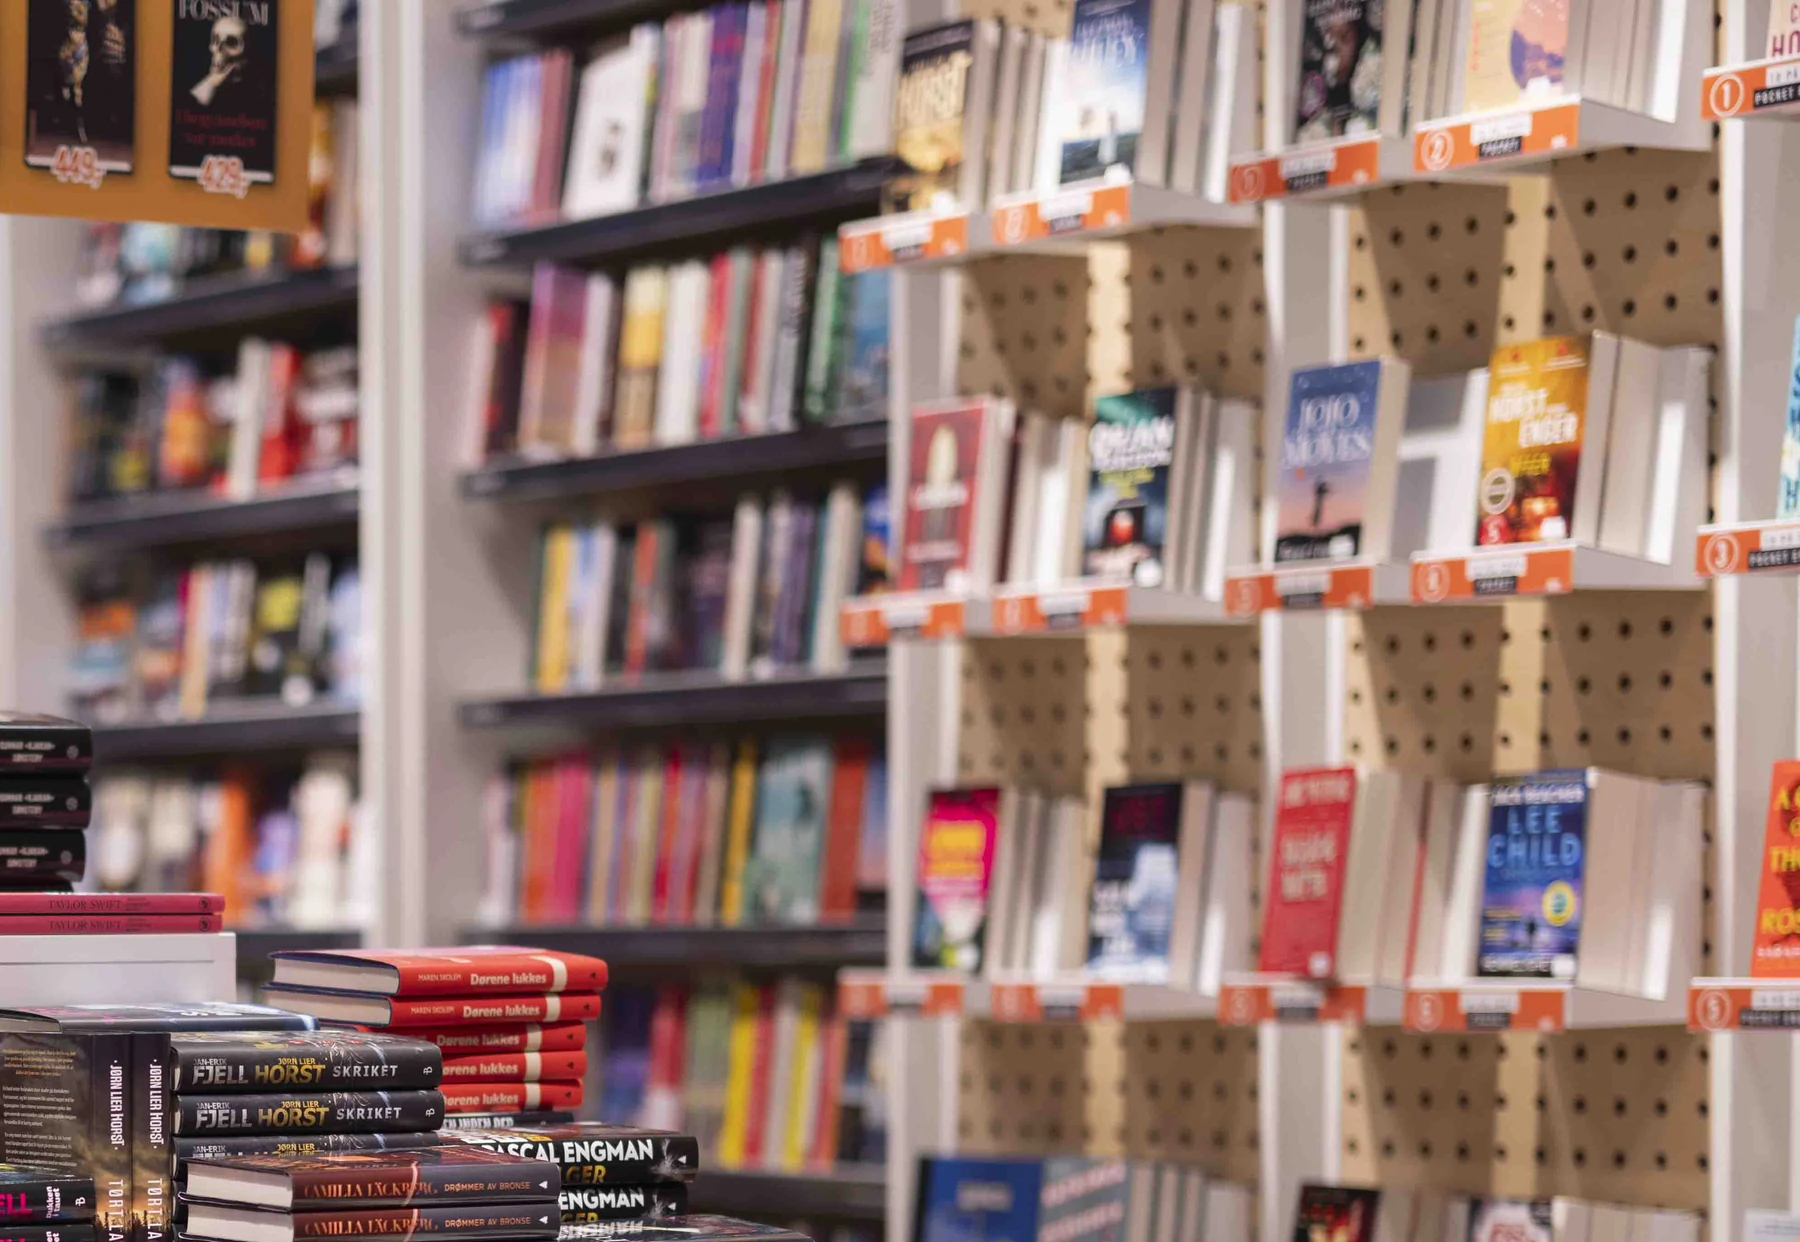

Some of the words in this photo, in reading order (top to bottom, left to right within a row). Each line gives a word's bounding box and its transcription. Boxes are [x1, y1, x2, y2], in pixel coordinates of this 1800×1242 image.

[1508, 805, 1562, 835] LEE
[1487, 832, 1581, 867] CHILD
[49, 900, 87, 910] TAYLOR
[90, 900, 121, 909] SWIFT
[418, 974, 441, 982] MAREN
[470, 973, 510, 986] Dørene
[512, 972, 546, 985] lukkes
[463, 1006, 503, 1018] Dørene
[505, 1005, 540, 1017] lukkes
[193, 1058, 227, 1066] JAN-ERIK
[300, 1057, 316, 1065] LIER
[110, 1065, 123, 1092] JØRN
[150, 1064, 162, 1090] JØRN
[192, 1065, 249, 1085] FJELL
[255, 1064, 326, 1084] HORST
[333, 1065, 398, 1078] SKRIKET
[110, 1094, 123, 1112] LIER
[150, 1092, 163, 1110] LIER
[195, 1109, 252, 1129] FJELL
[258, 1108, 329, 1127] HORST
[337, 1107, 402, 1120] SKRIKET
[110, 1113, 124, 1145] HORST
[150, 1112, 164, 1144] HORST
[563, 1139, 653, 1162] ENGMAN
[304, 1184, 363, 1198] CAMILLA
[444, 1183, 484, 1192] DRØMMER
[499, 1182, 531, 1190] BRONSE
[108, 1179, 124, 1218] TØRT
[147, 1178, 163, 1217] TØRT
[558, 1187, 645, 1210] ENGMAN
[305, 1222, 363, 1235] CAMILLA
